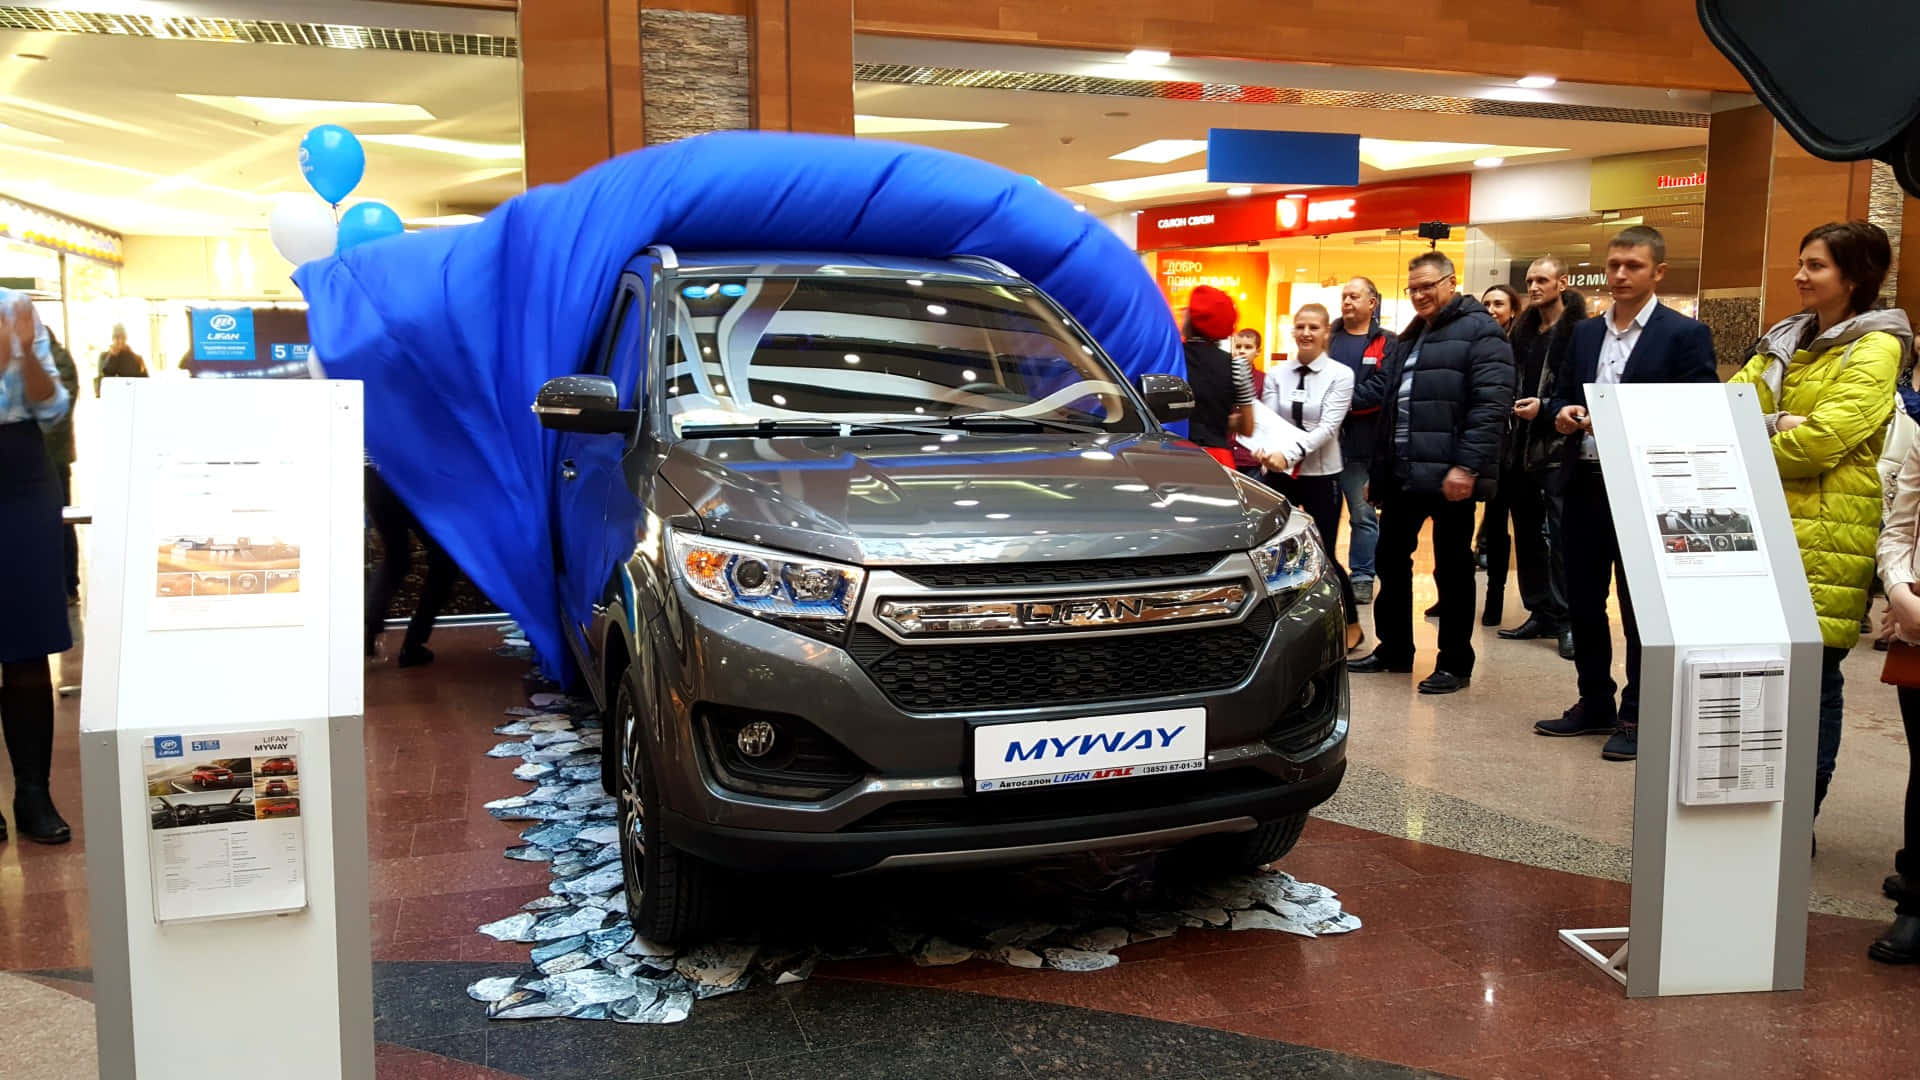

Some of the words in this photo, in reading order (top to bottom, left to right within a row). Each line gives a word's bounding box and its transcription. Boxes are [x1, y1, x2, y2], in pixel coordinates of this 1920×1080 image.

[1657, 172, 1705, 189] Humid
[1167, 262, 1203, 274] ДОБРО
[207, 332, 240, 341] LIFAN
[275, 344, 287, 359] 5
[1023, 599, 1144, 624] LIFAN
[263, 735, 288, 744] LIFAN
[1004, 725, 1187, 763] MYWAY
[254, 743, 289, 752] MYWAY
[999, 777, 1051, 789] Автосалон
[1053, 771, 1090, 783] LIFAN
[1142, 764, 1168, 775] (3852)
